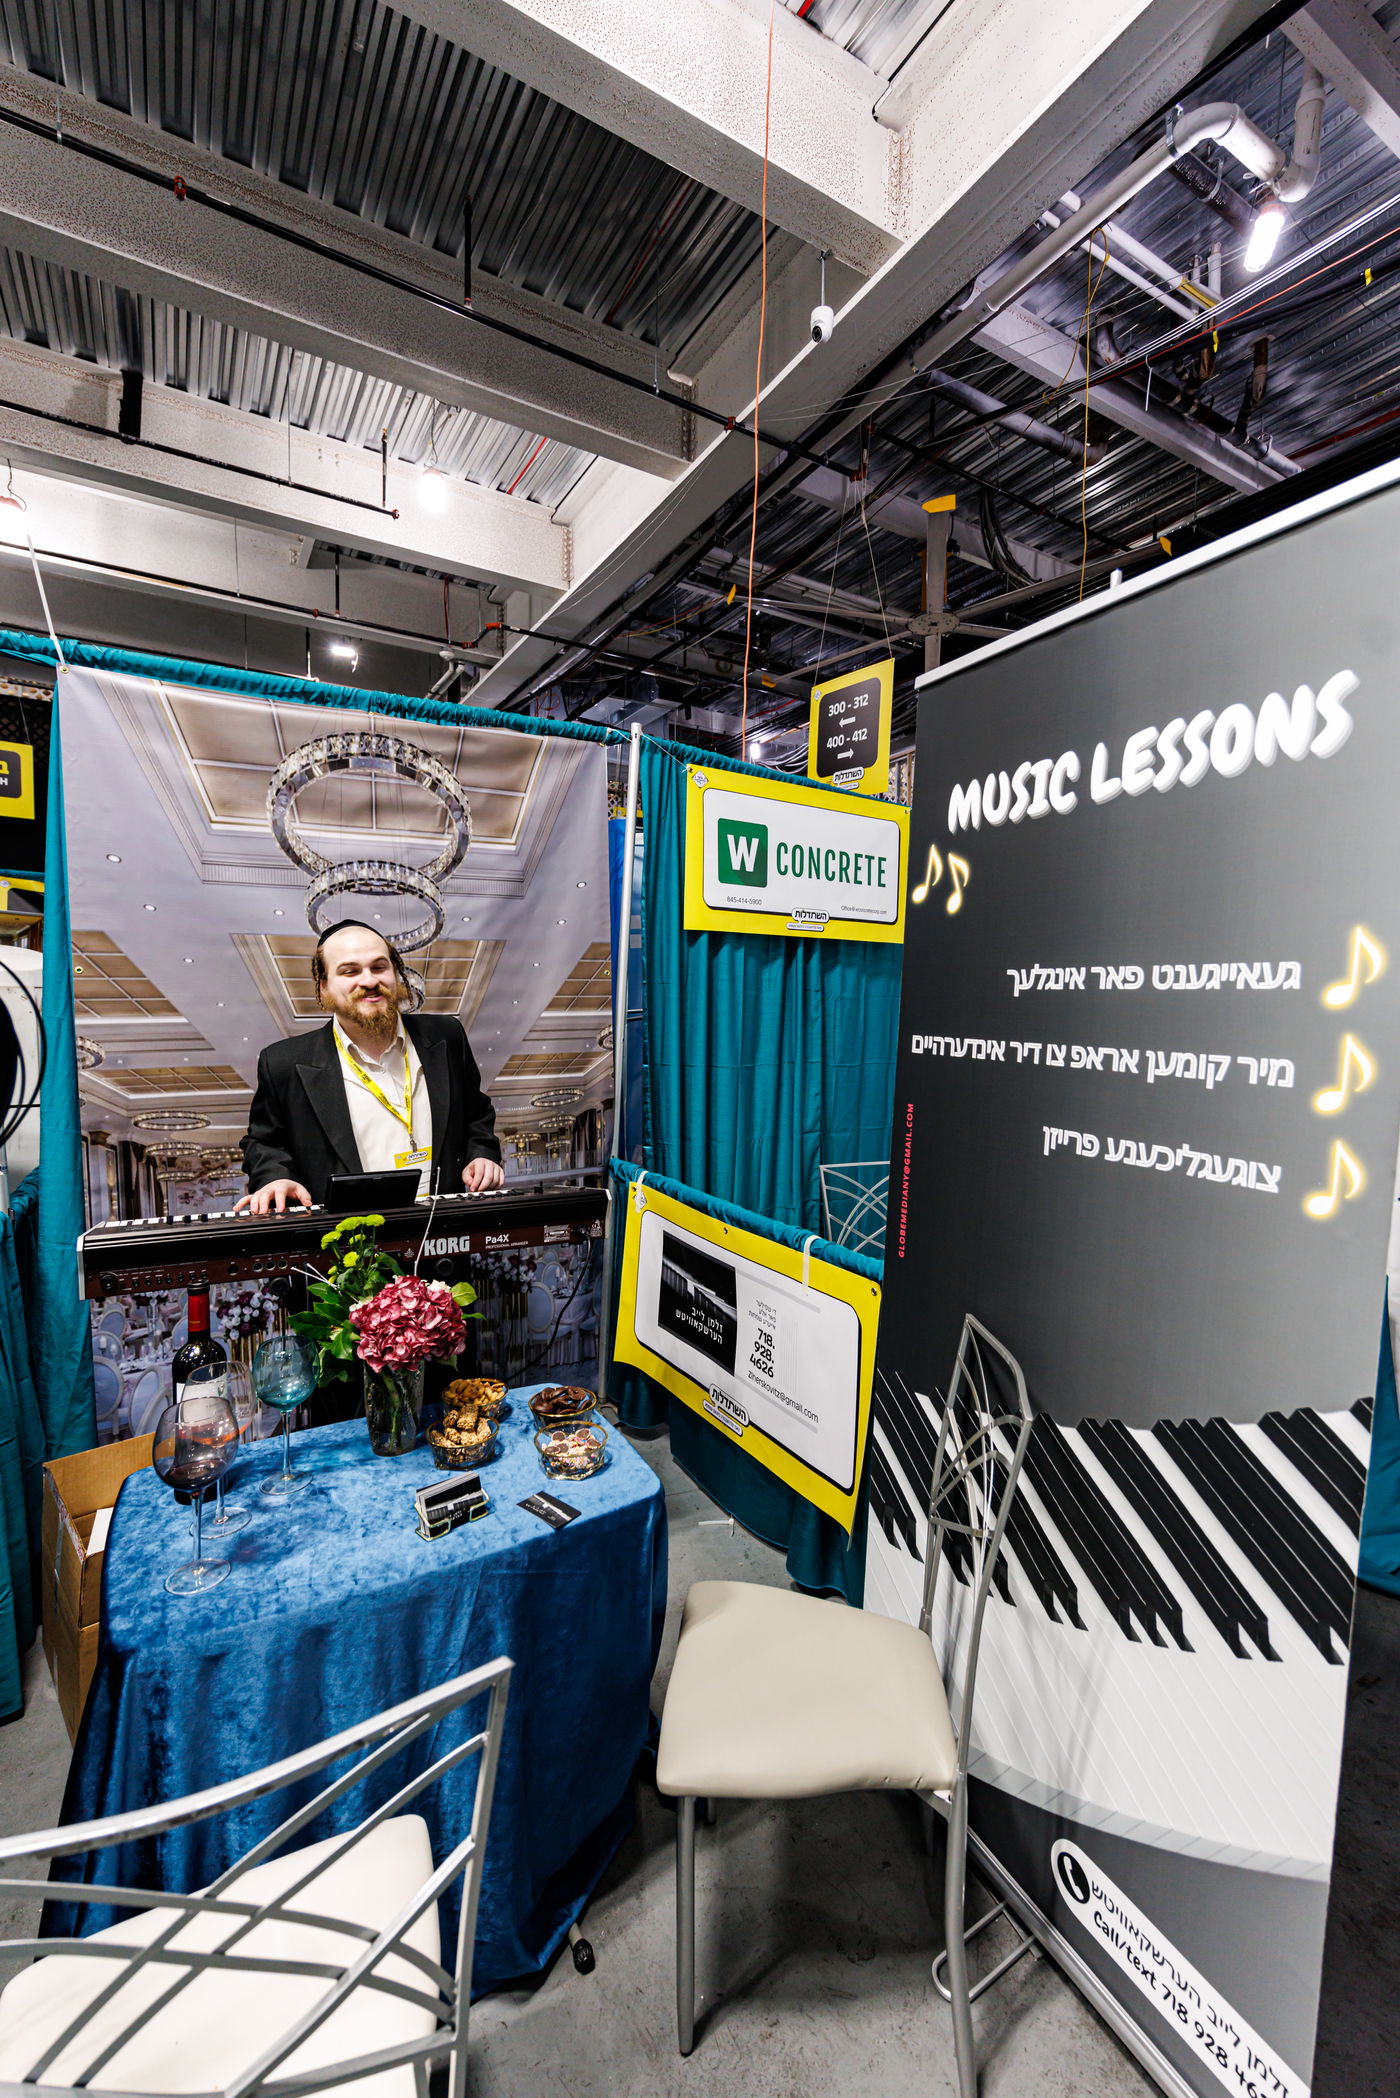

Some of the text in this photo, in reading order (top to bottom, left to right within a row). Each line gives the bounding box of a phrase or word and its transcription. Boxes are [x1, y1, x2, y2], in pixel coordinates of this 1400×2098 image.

[828, 701, 846, 717] 300
[853, 694, 869, 709] 312
[826, 734, 845, 749] 400
[852, 728, 868, 742] 412
[947, 669, 1360, 834] MUSIC LESSONS
[834, 769, 863, 780] השתדלות
[727, 834, 887, 888] W CONCRETE
[794, 910, 827, 920] השתדלות
[1006, 961, 1301, 997] געאייגענט פאר אינגלעך
[911, 1034, 1295, 1089] מיר קומען אראפ צו דיר אינדערהיים
[1043, 1126, 1282, 1194] צוגעגליכענע פרייזן
[898, 1103, 914, 1258] GLOBEMEDIANY@GMAIL.COM
[424, 1236, 470, 1257] KORG
[485, 1234, 509, 1245] Pa4X
[675, 1309, 723, 1345] הערשקאוויטש
[691, 1307, 723, 1334] זלמן לייב
[754, 1341, 774, 1363] 928.
[757, 1328, 775, 1349] 718.
[749, 1353, 774, 1378] 4626
[712, 1388, 747, 1422] השתדלות
[1091, 1880, 1201, 2009] הערשקאוויטש
[1093, 1911, 1157, 1990] Call/text
[1162, 1983, 1188, 2024] 718
[1195, 2021, 1228, 2069] 928
[1207, 2004, 1241, 2047] לייב
